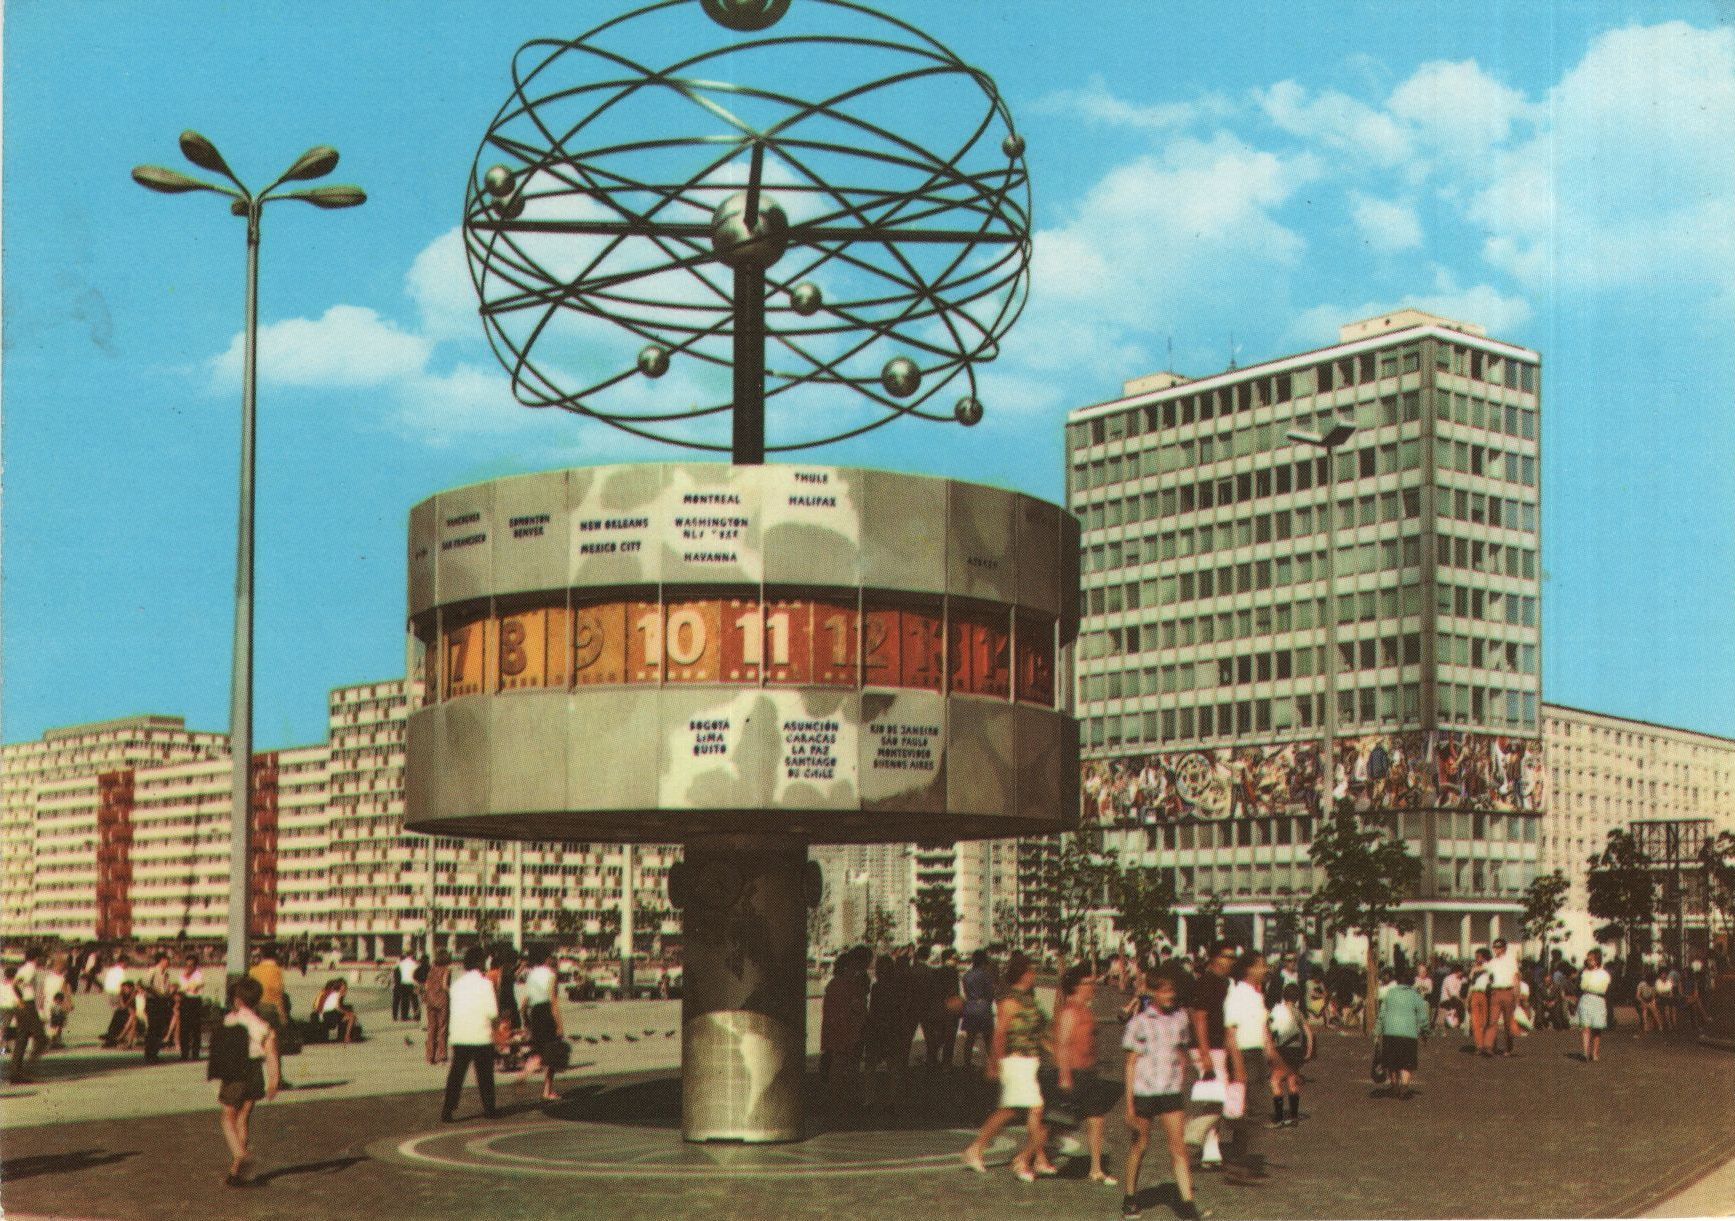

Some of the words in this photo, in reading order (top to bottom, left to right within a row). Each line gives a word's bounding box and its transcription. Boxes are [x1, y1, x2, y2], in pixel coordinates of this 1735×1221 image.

[683, 494, 740, 505] MONTREAL
[789, 495, 836, 507] HALIFAX
[580, 519, 602, 531] NEW
[605, 517, 649, 530] ORLEANS
[675, 517, 749, 528] WASHINGTON
[620, 540, 641, 553] CITY
[684, 552, 737, 563] HAVANNA
[637, 611, 707, 667] 10
[735, 613, 790, 667] 11
[501, 620, 527, 677] 8
[696, 733, 724, 743] LIMA
[786, 732, 836, 744] CARACAS
[694, 744, 727, 756] QUITO
[792, 744, 805, 755] LA
[810, 744, 831, 755] PAZ
[785, 755, 837, 767] SANTIAGO
